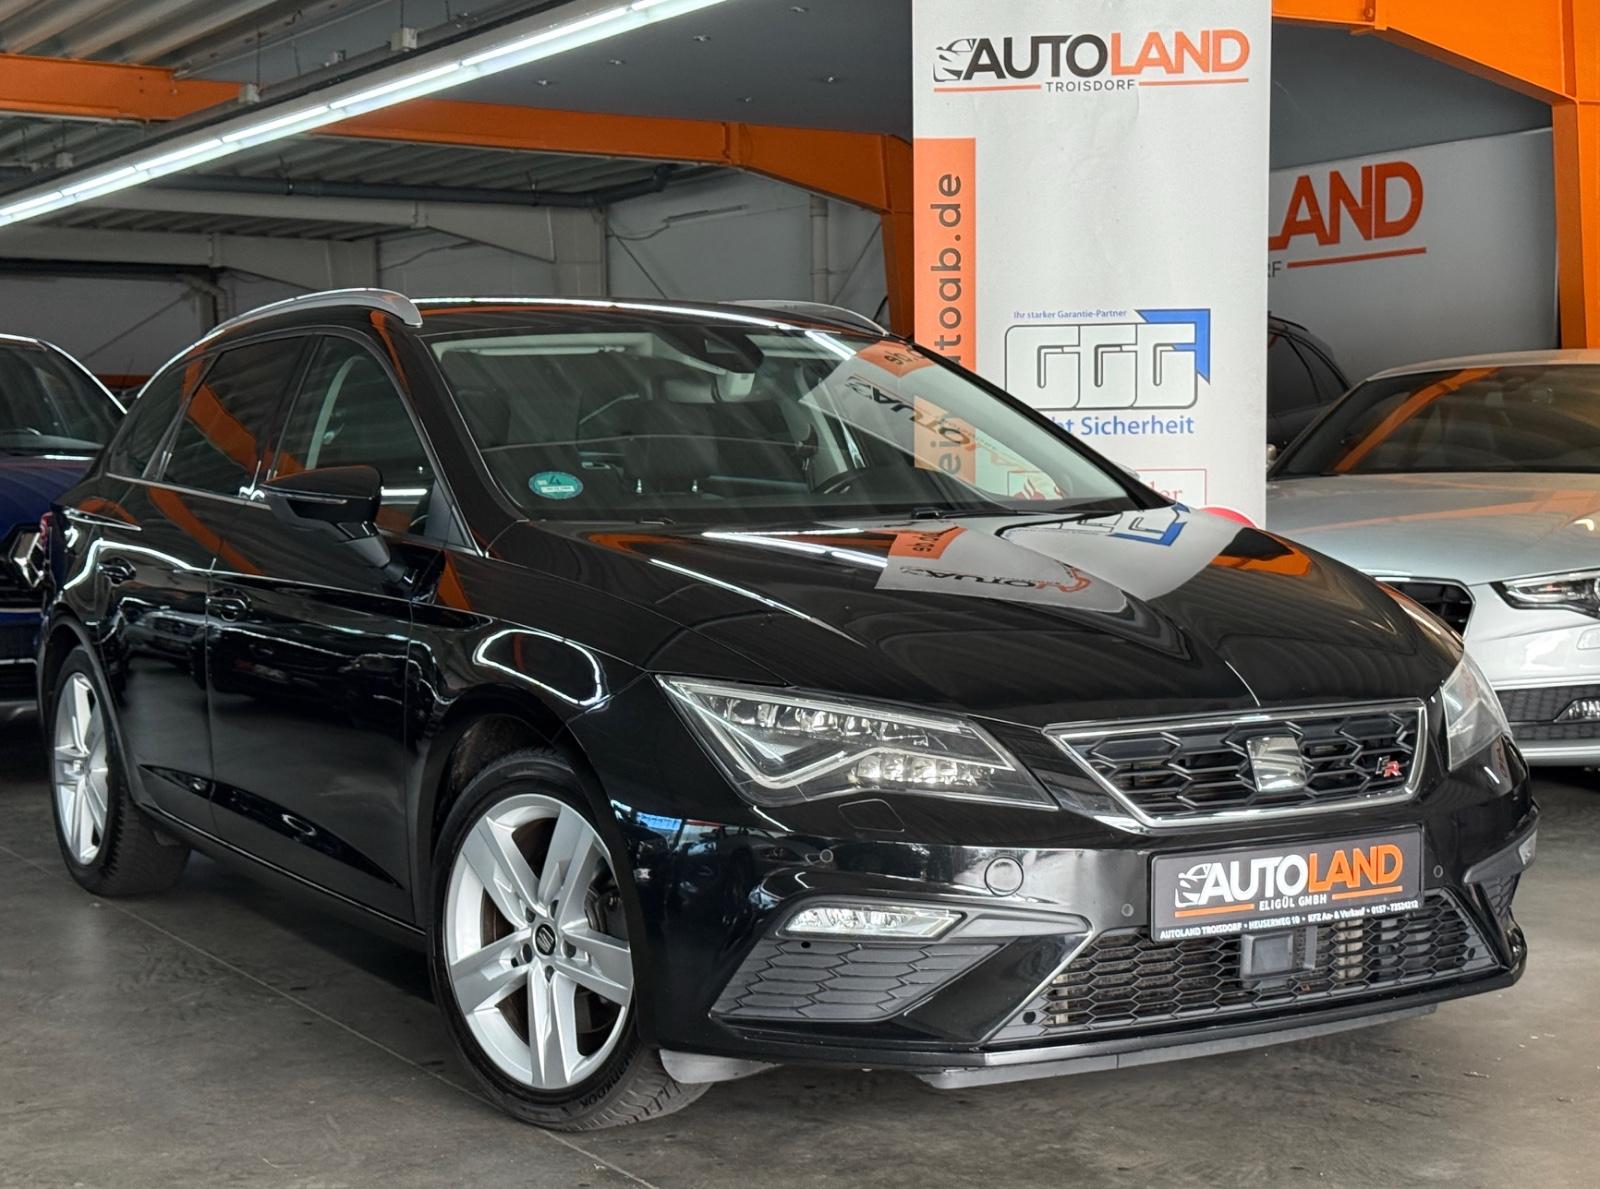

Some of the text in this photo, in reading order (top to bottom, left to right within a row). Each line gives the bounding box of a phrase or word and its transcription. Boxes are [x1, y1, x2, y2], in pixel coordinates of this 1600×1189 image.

[962, 29, 1250, 81] AUTOLAND
[1045, 79, 1136, 92] TROISDORF
[1013, 309, 1128, 319] Ihr starker Garantie-Partner
[1081, 415, 1194, 435] Sicherheit
[1197, 844, 1404, 905] AUTOLAND
[1298, 893, 1327, 907] GMBH
[1160, 926, 1201, 939] AUTOLAND
[1201, 922, 1242, 935] TROISDORF
